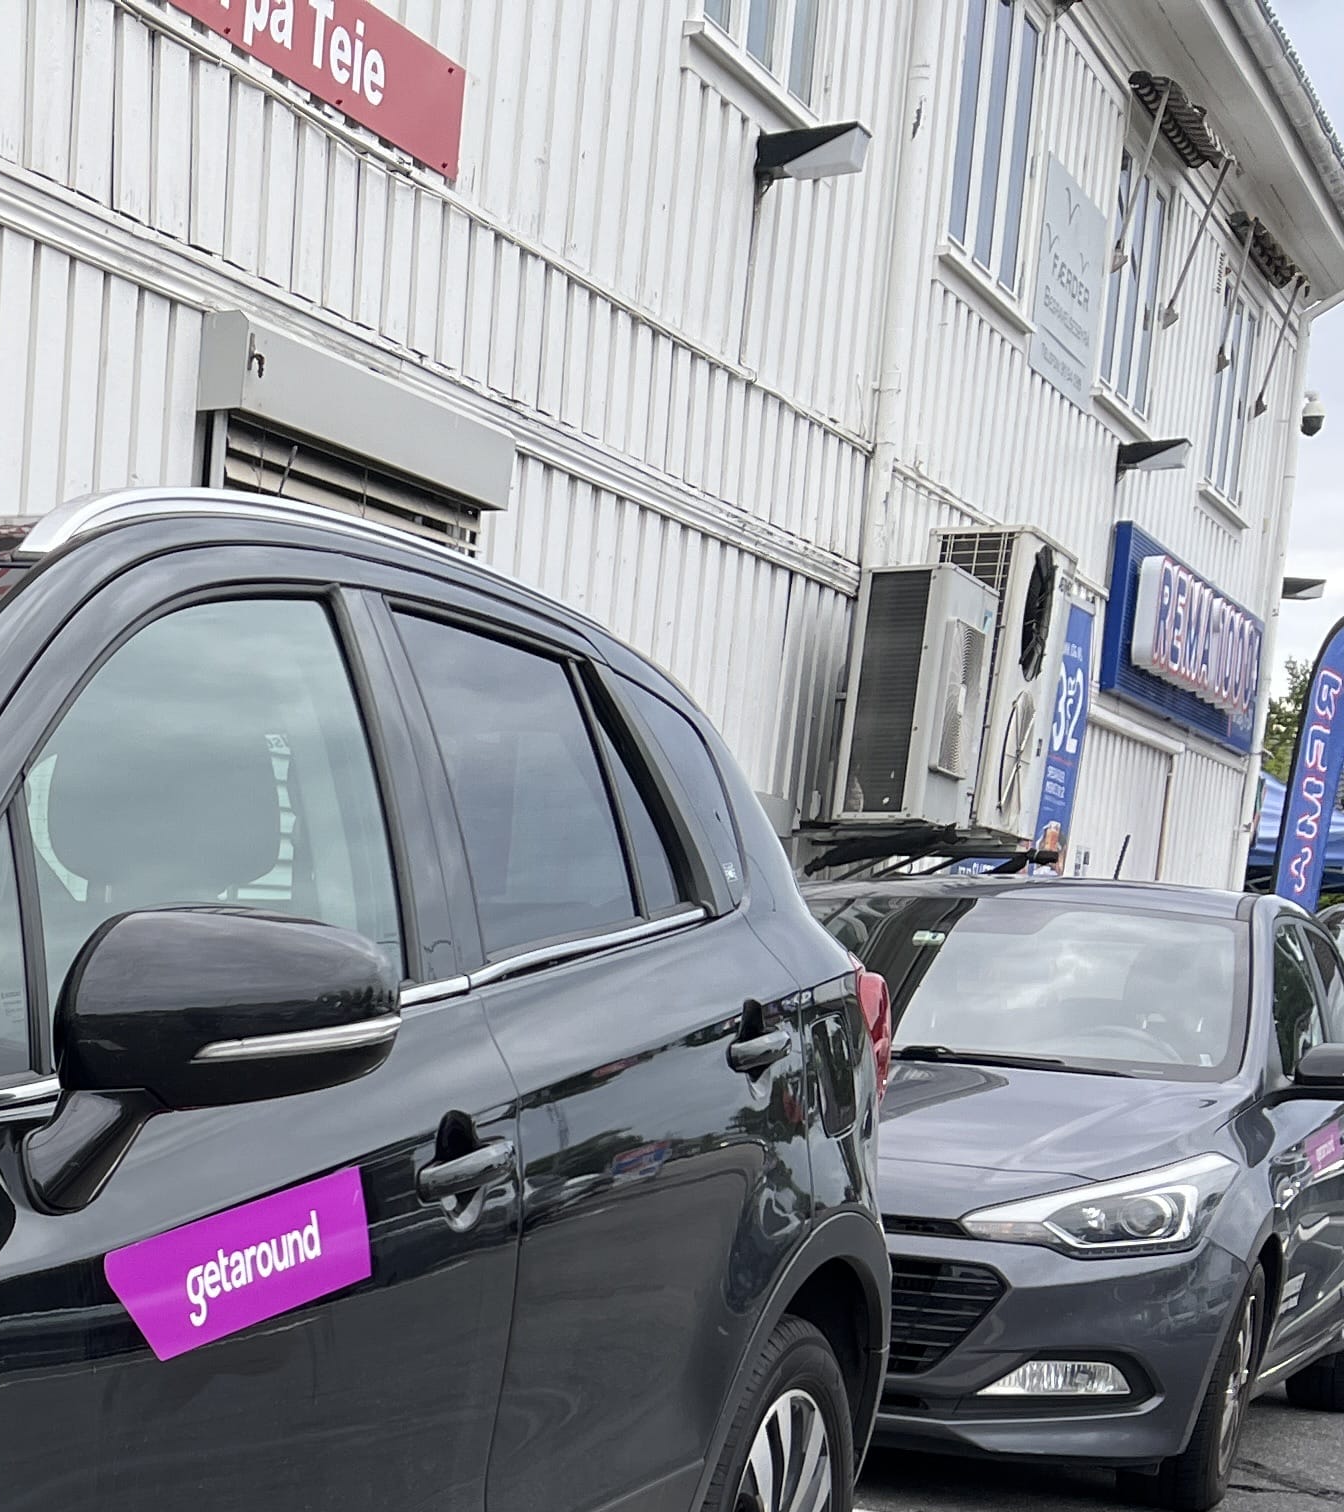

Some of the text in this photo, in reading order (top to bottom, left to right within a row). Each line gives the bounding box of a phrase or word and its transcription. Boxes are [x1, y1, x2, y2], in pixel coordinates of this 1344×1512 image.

[309, 0, 385, 106] Teie
[1052, 252, 1090, 313] FÆRDER
[1152, 555, 1212, 691] REMA
[186, 1210, 321, 1327] getaround
